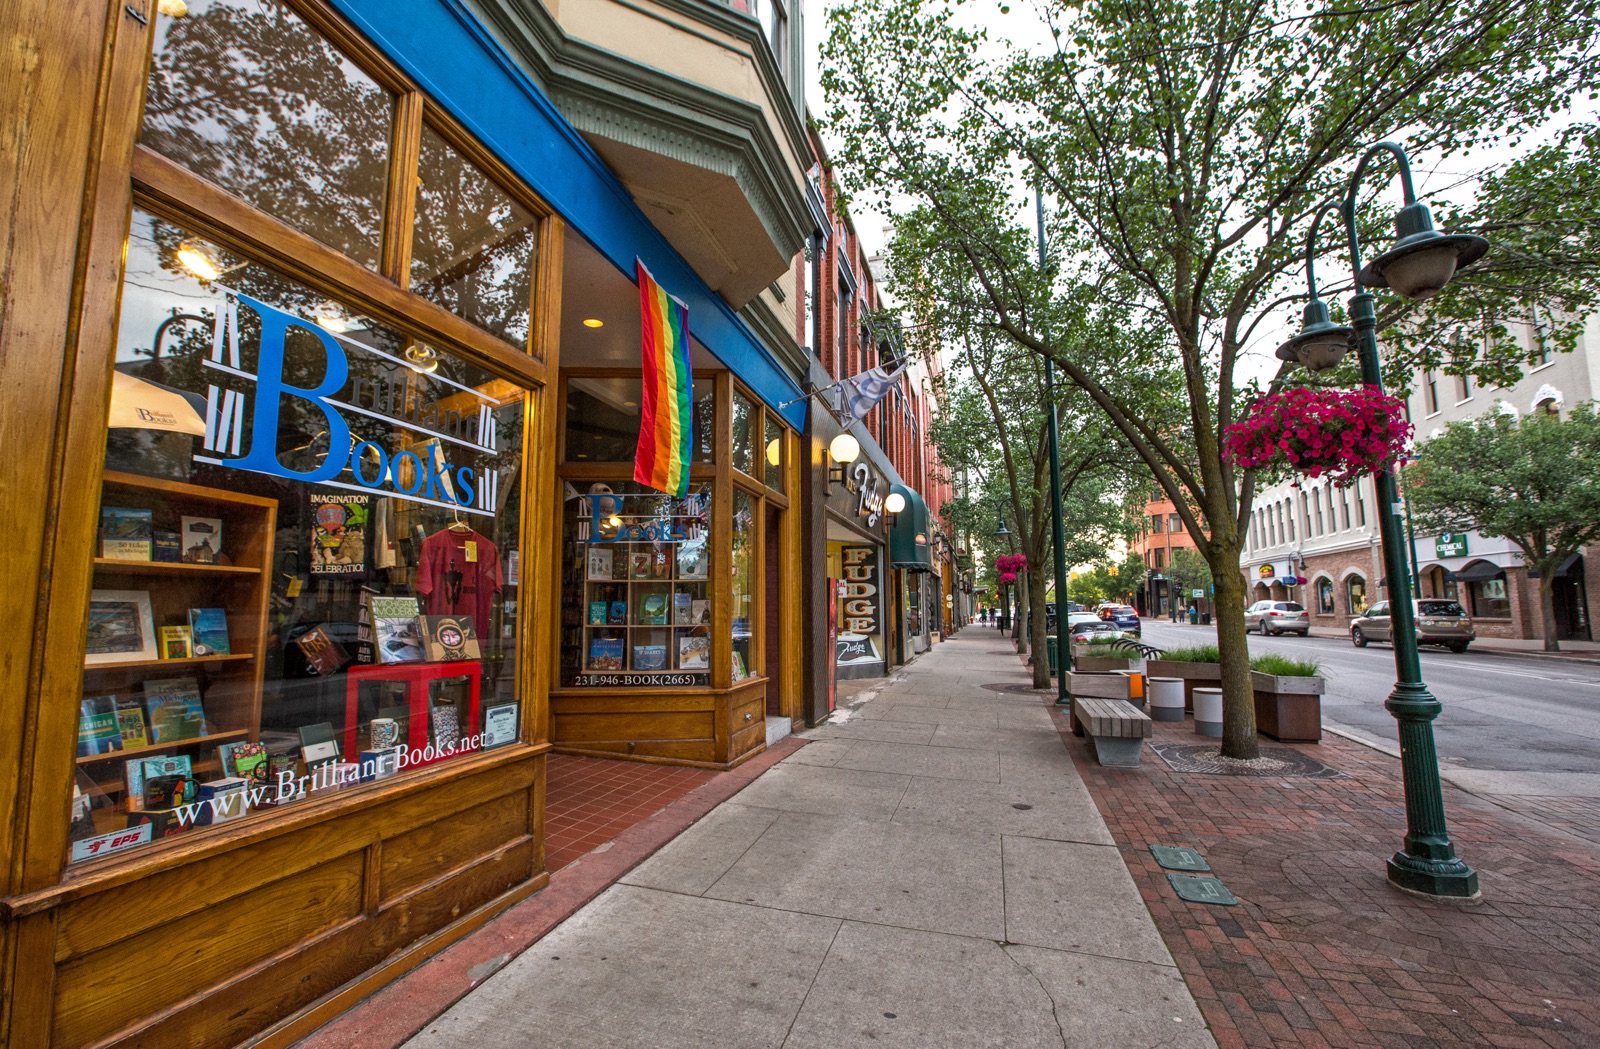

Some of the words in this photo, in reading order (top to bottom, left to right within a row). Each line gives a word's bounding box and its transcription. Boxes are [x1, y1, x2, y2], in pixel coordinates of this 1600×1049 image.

[222, 292, 475, 507] Books
[310, 494, 369, 504] IMAGINATION
[585, 493, 687, 544] Books
[1437, 542, 1463, 552] CHEMICAL
[843, 548, 877, 634] FUDGE
[375, 607, 418, 616] MODERN
[837, 641, 866, 660] Fudge
[575, 674, 696, 687] 231-946-BOOK(2665)
[172, 730, 487, 827] www.Brilliant-Books.net
[110, 831, 142, 848] EPS
